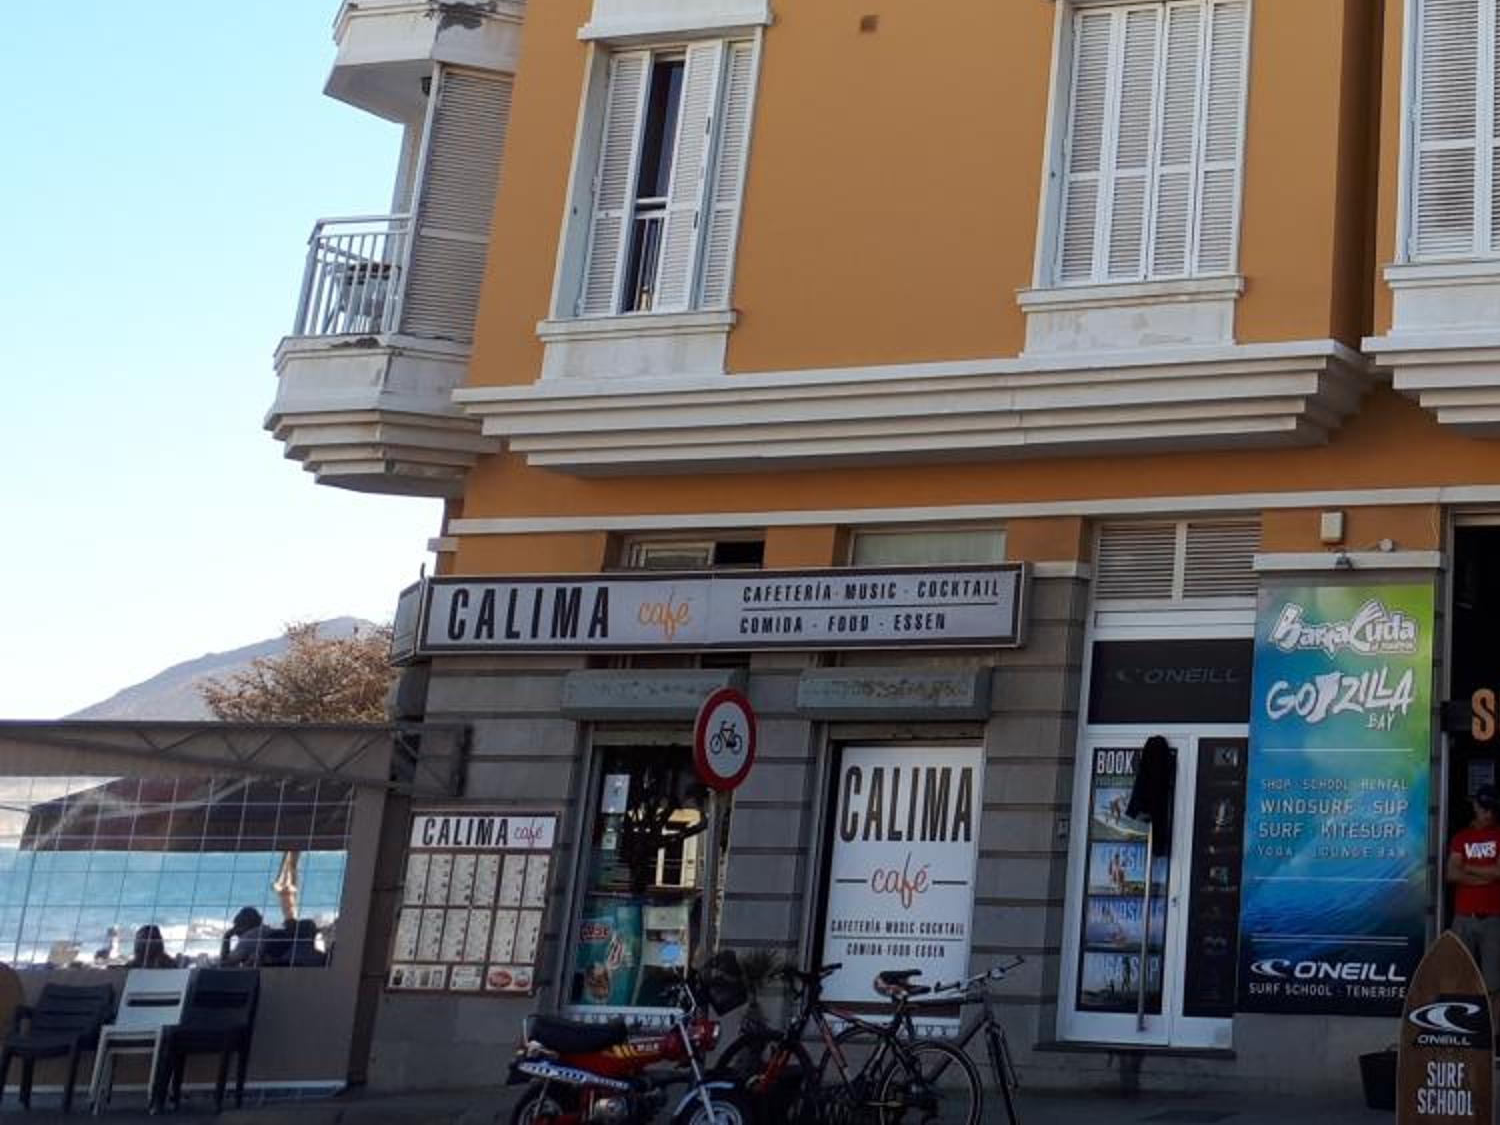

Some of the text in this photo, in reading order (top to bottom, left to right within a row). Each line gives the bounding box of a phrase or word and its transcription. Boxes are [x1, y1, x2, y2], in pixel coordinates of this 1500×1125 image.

[743, 578, 999, 603] CAFETERÍA MUSIC COCKTAIL
[448, 585, 691, 643] CALIMA café
[740, 613, 945, 634] COMIDA FOOD ESSEN
[1368, 713, 1397, 731] BAY
[1096, 751, 1135, 774] BOOK
[1303, 778, 1348, 790] SCHOOL
[1360, 778, 1408, 791] RENTAL
[840, 765, 973, 842] CALIMA
[1261, 798, 1409, 815] WINDSURF SUP
[422, 818, 509, 846] CALIMA
[1259, 822, 1406, 839] SURF KITESURF
[1257, 845, 1294, 858] YOGA
[1464, 840, 1498, 860] VANS
[871, 851, 930, 910] café
[831, 918, 964, 936] CAFETERÍA MUSIC COCKTAIL
[847, 943, 945, 958] COMIDA FOOD ESSEN
[1294, 961, 1407, 981] O'NEILL
[1249, 982, 1407, 999] SURF SCHOOL TENERIFE
[1426, 1062, 1465, 1088] SURF
[1417, 1089, 1474, 1116] SCHOOL
